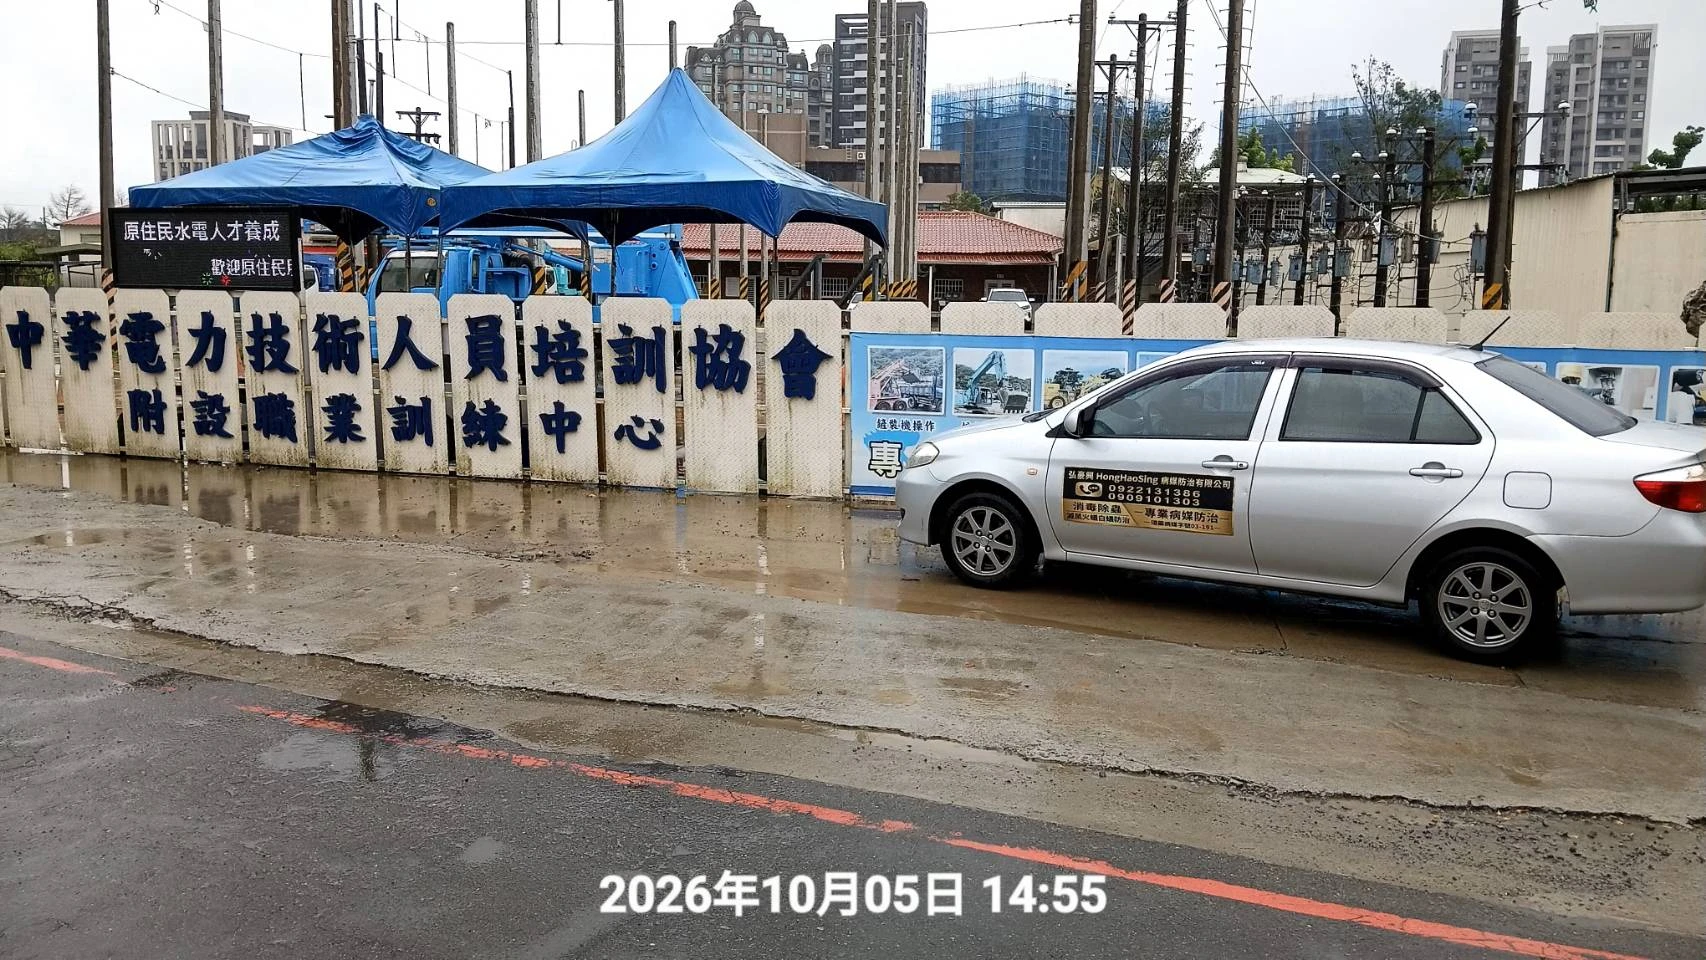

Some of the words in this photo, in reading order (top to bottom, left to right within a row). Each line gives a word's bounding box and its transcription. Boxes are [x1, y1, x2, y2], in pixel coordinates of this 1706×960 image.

[124, 220, 280, 242] 原住民水電人才養成
[5, 310, 833, 401] 中華電力技術人員培訓協會
[127, 388, 665, 454] 附設職業訓練中心
[868, 440, 903, 478] 專
[1096, 472, 1158, 486] HongHaoSing
[1160, 476, 1231, 490] 病媒防治有限公司
[1072, 501, 1122, 514] 消毒除蟲
[1108, 493, 1200, 507] 0909101303
[1144, 507, 1219, 524] 專業病媒防治
